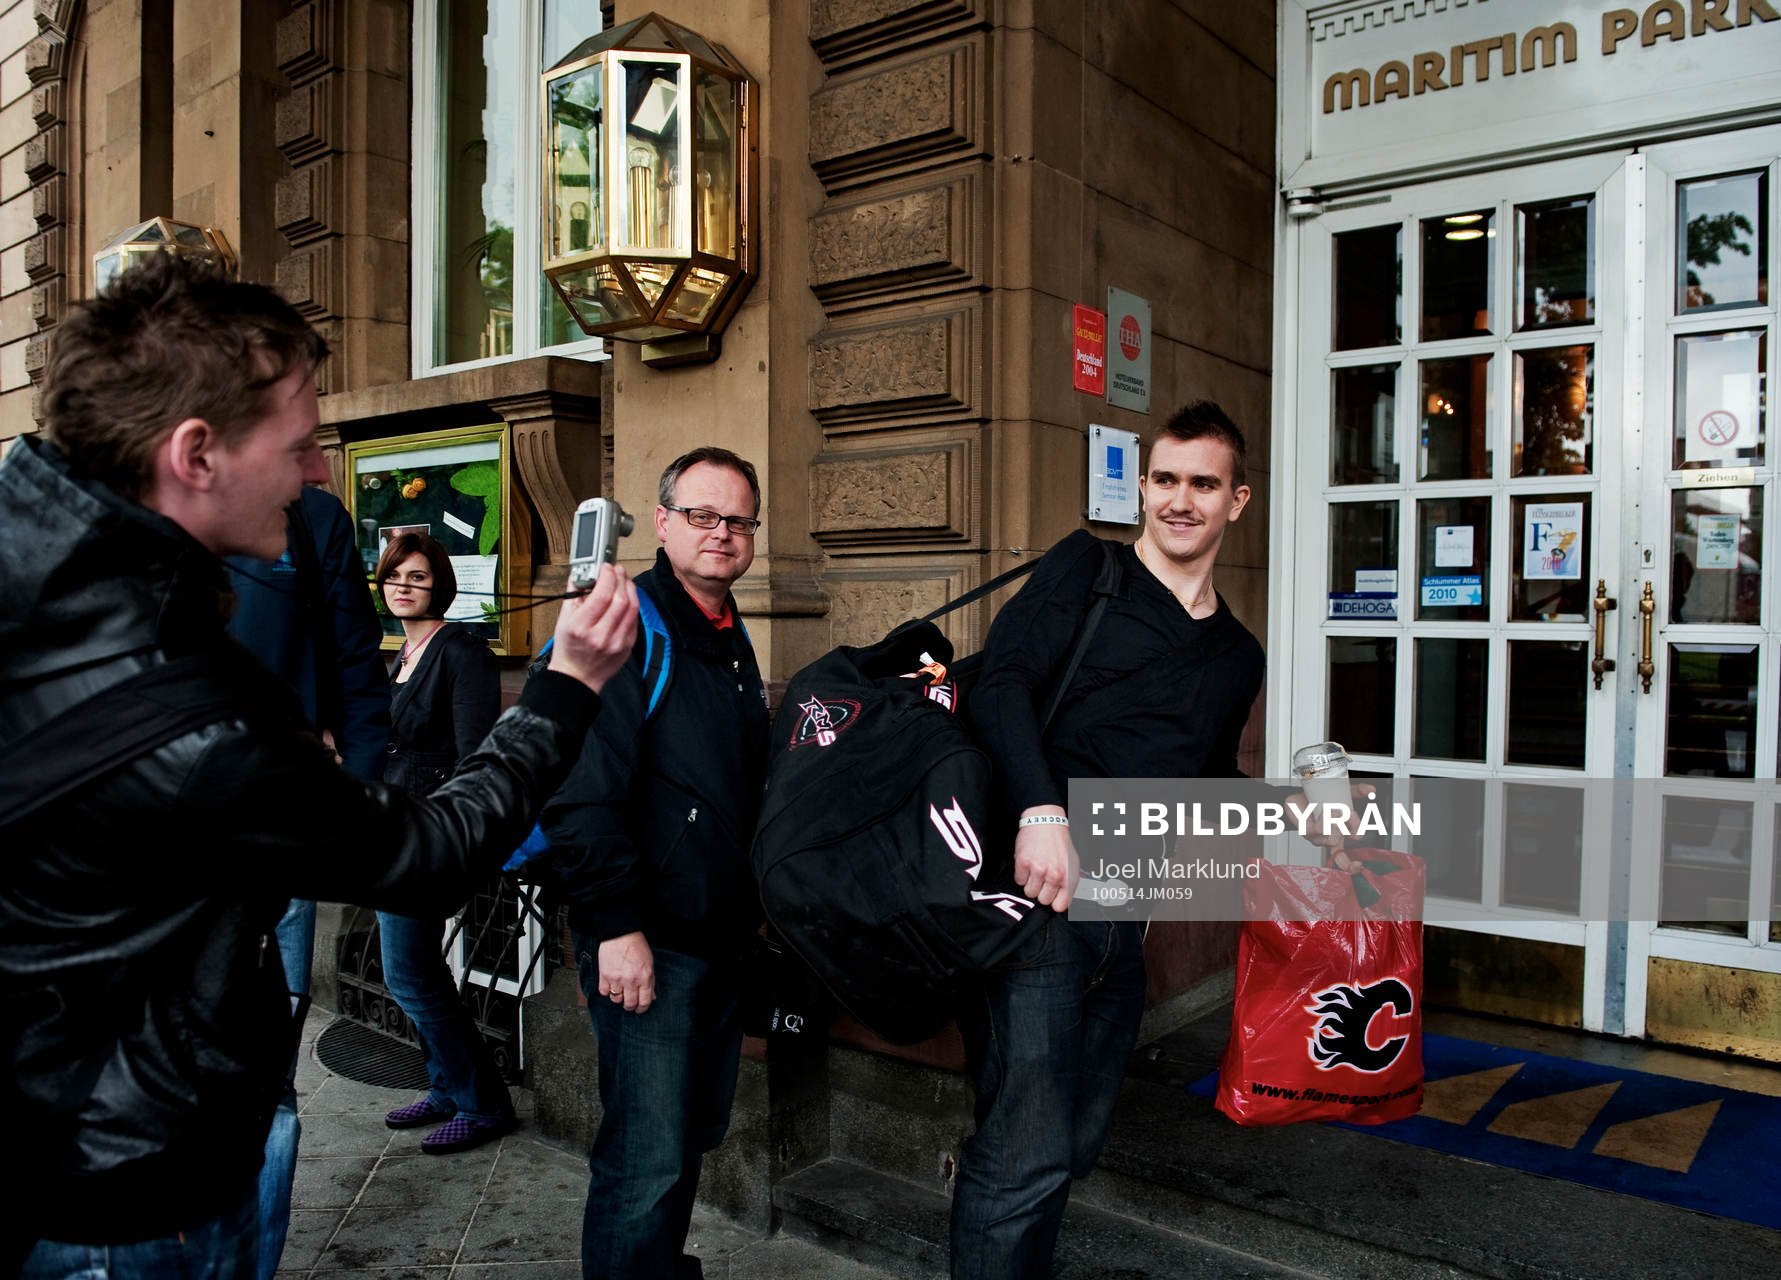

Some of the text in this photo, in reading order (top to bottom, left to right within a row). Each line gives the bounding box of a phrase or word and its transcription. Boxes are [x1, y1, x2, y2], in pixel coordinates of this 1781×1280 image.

[1323, 0, 1781, 115] MARITIM PARK
[1076, 348, 1103, 368] Deutschland
[1081, 363, 1098, 378] 2004
[1698, 473, 1739, 483] Ziehen
[1528, 522, 1553, 552] F
[1541, 555, 1562, 570] 2010
[1423, 576, 1480, 586] Schlummer Atlas
[1428, 588, 1457, 600] 2010
[1342, 602, 1395, 615] DEHOGA
